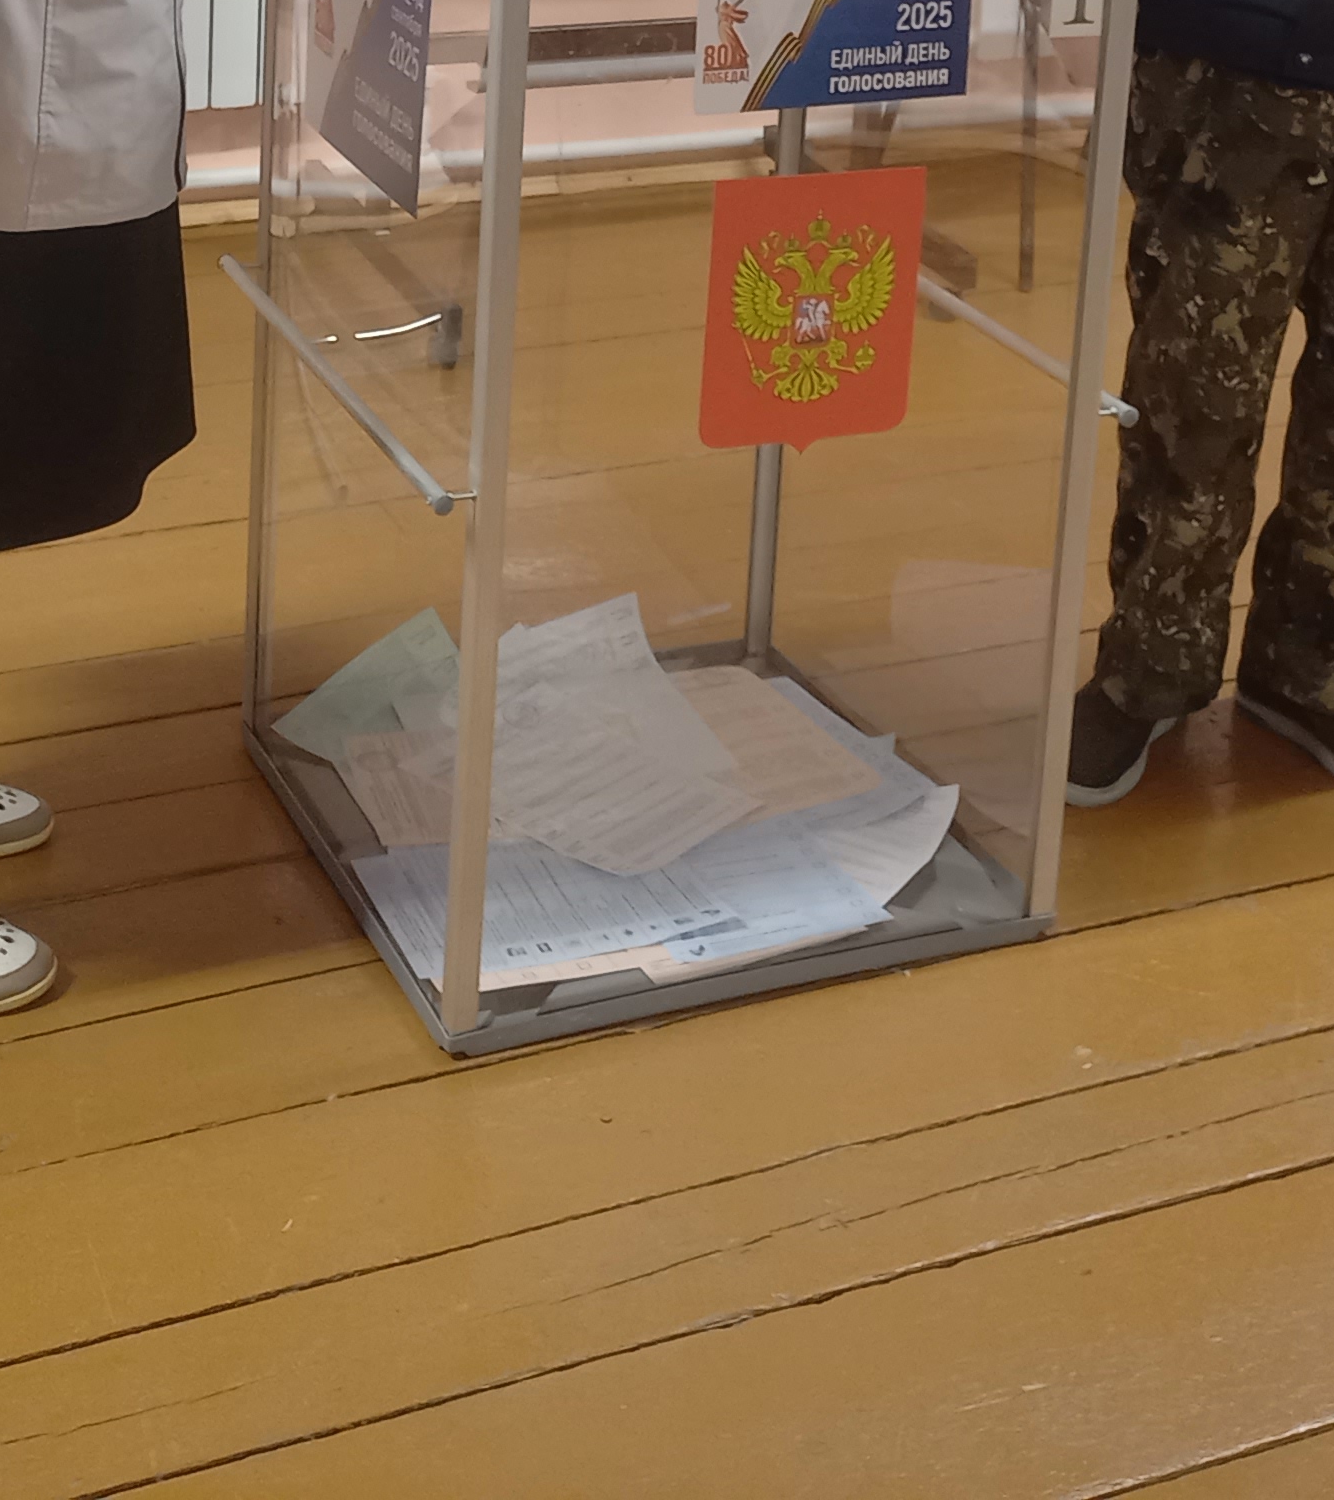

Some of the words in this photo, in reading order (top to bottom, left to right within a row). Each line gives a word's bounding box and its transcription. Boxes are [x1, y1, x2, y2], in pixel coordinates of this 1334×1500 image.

[895, 1, 953, 32] 2025
[388, 30, 420, 83] 2025
[703, 44, 731, 69] 80
[830, 40, 902, 70] ЕДИНЫЙ
[905, 41, 950, 66] ДЕНЬ
[829, 68, 949, 94] голосования
